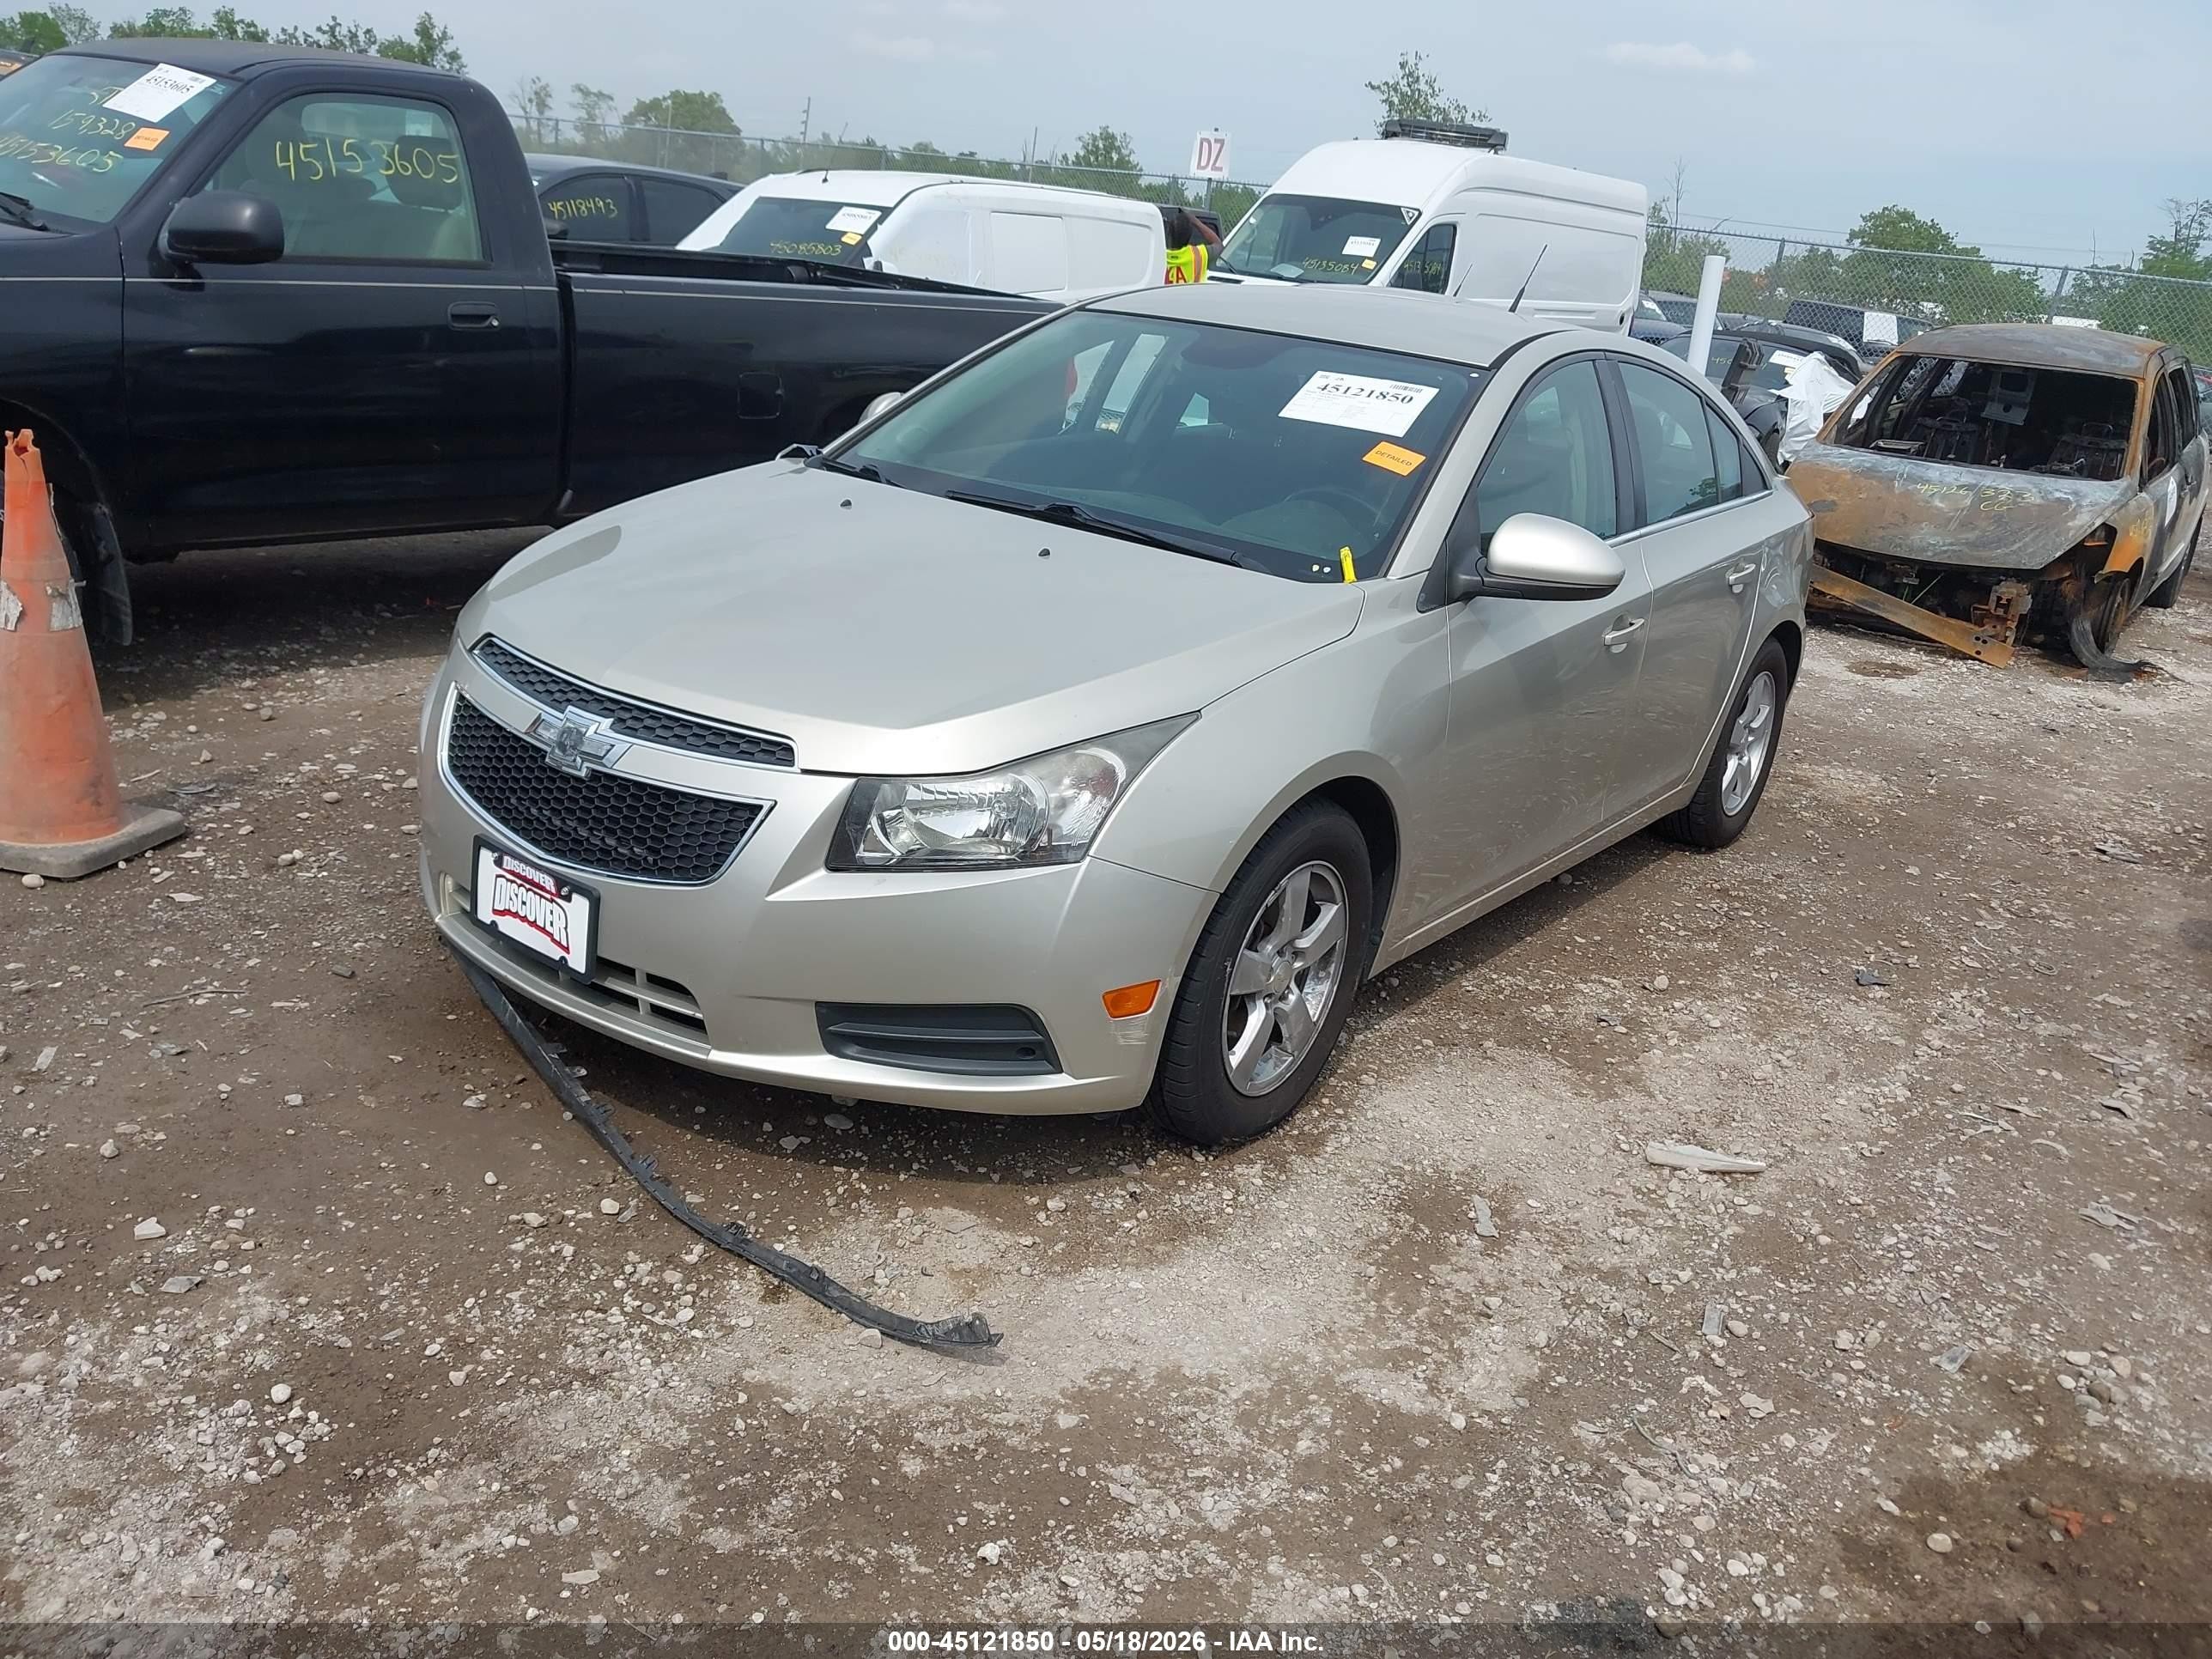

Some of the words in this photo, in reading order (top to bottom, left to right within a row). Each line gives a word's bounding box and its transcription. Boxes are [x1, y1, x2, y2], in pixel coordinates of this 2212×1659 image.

[276, 137, 460, 183] 45153605
[1196, 137, 1224, 172] DZ
[547, 197, 617, 220] 45118493
[1316, 383, 1414, 404] 45121850
[1376, 450, 1413, 466] DETAILED
[502, 854, 557, 895] DISCOVER
[494, 876, 568, 950] DISCOVER
